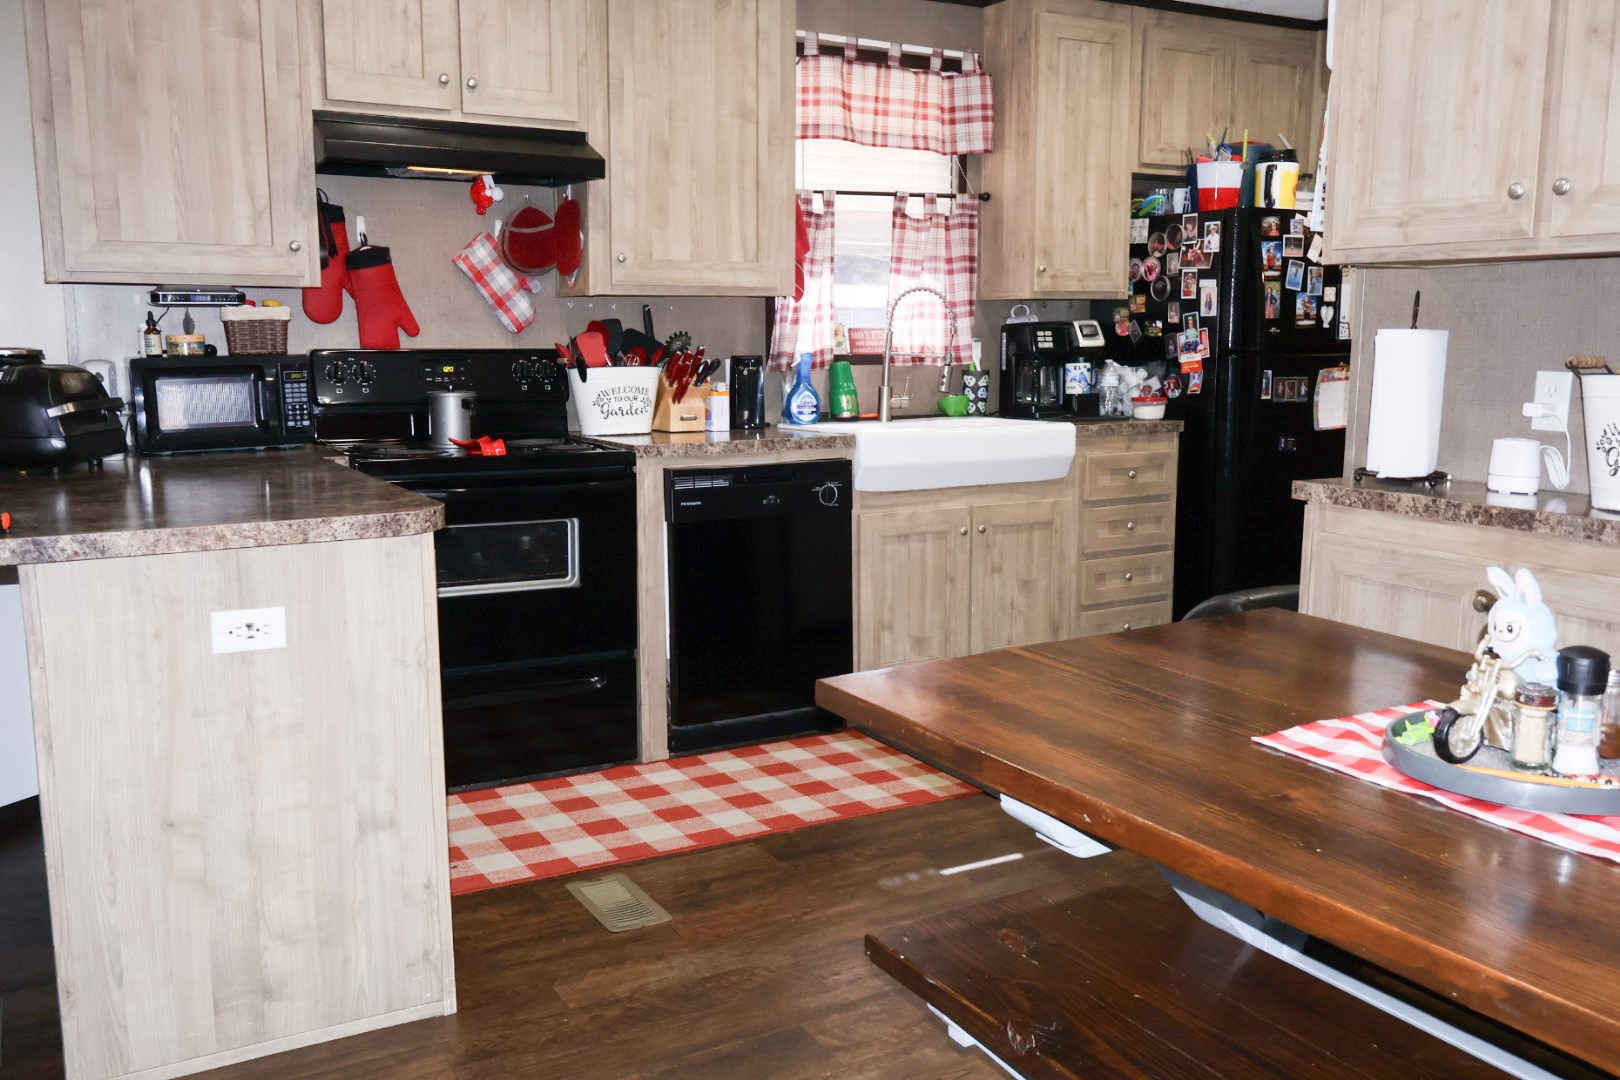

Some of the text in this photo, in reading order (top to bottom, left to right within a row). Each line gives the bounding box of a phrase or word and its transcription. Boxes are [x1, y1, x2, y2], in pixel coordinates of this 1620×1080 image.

[850, 330, 869, 341] NANA'S
[600, 386, 649, 397] WELCOME
[600, 402, 648, 419] Garden
